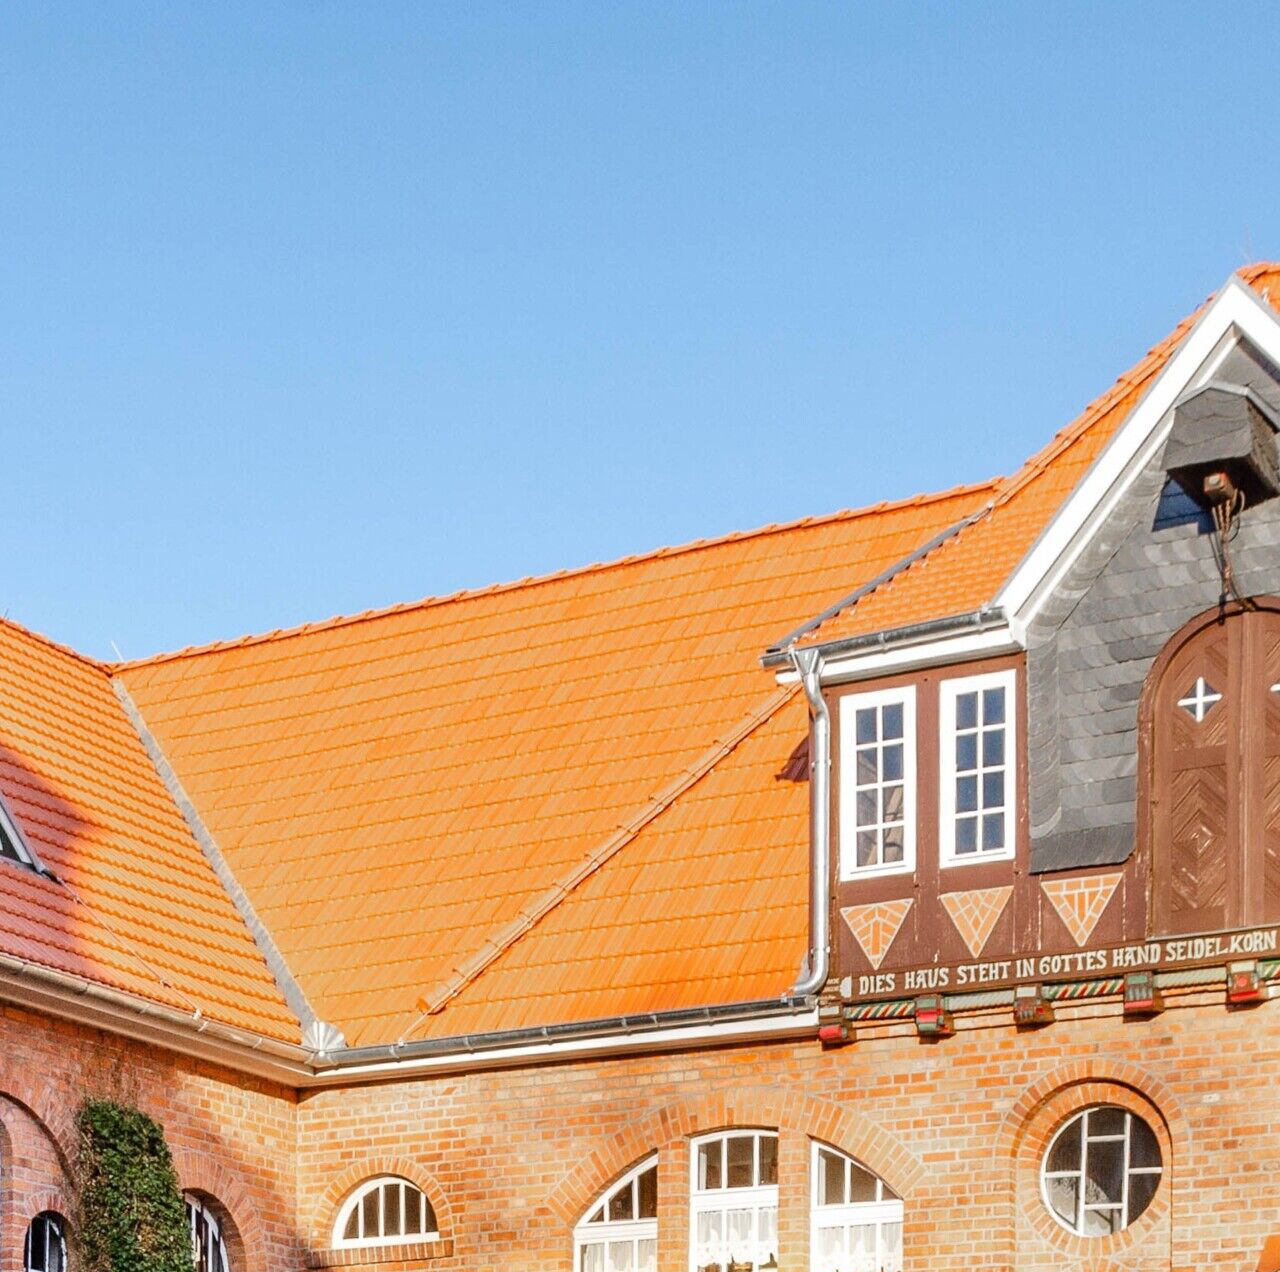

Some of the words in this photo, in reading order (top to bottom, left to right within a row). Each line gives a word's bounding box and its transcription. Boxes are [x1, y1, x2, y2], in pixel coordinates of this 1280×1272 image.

[859, 973, 896, 995] DIES
[904, 967, 950, 989] HAUS
[956, 961, 1011, 985] STEHT
[1016, 958, 1035, 978] IN
[1039, 950, 1108, 975] GOTTES
[1112, 944, 1162, 968] HAND
